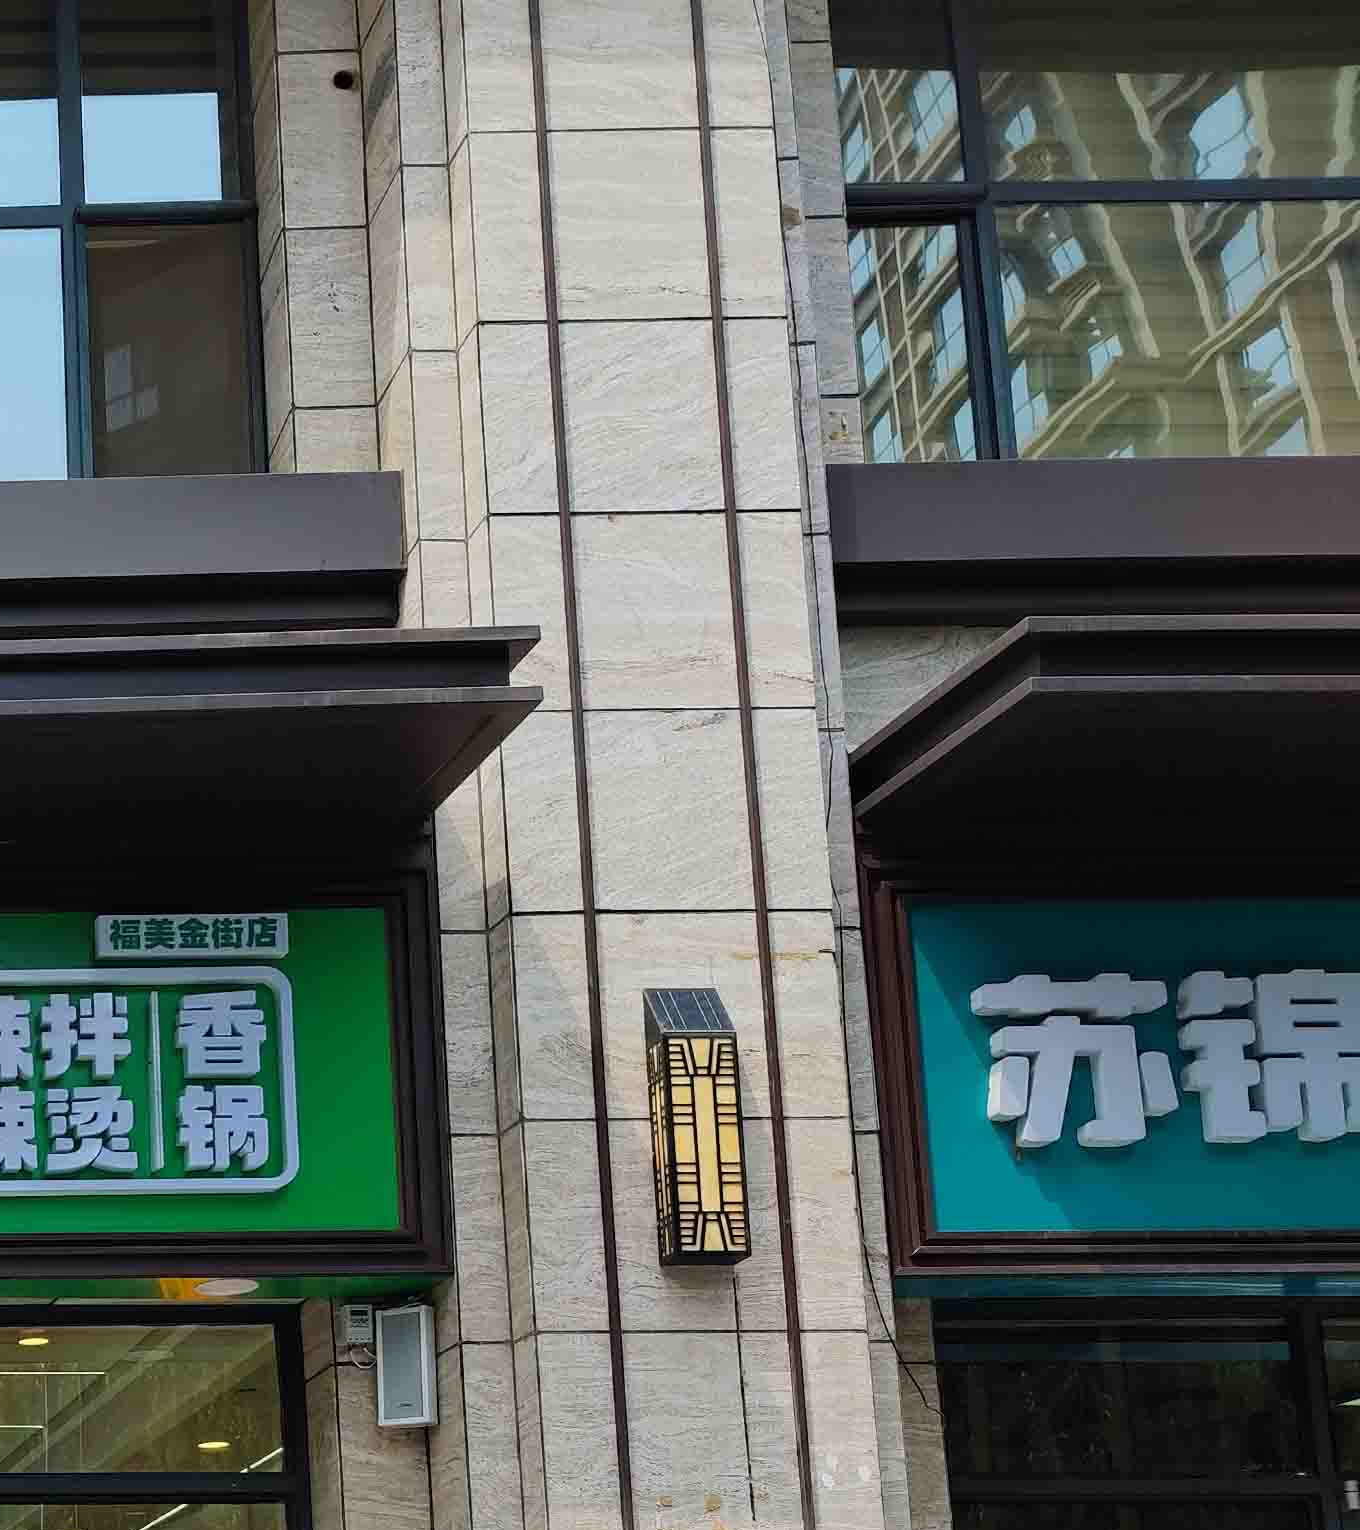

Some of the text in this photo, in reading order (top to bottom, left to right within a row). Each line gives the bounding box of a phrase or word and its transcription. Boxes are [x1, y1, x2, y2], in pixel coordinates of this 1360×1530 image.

[109, 916, 278, 952] 福美金街店
[970, 968, 1360, 1149] 苏锦
